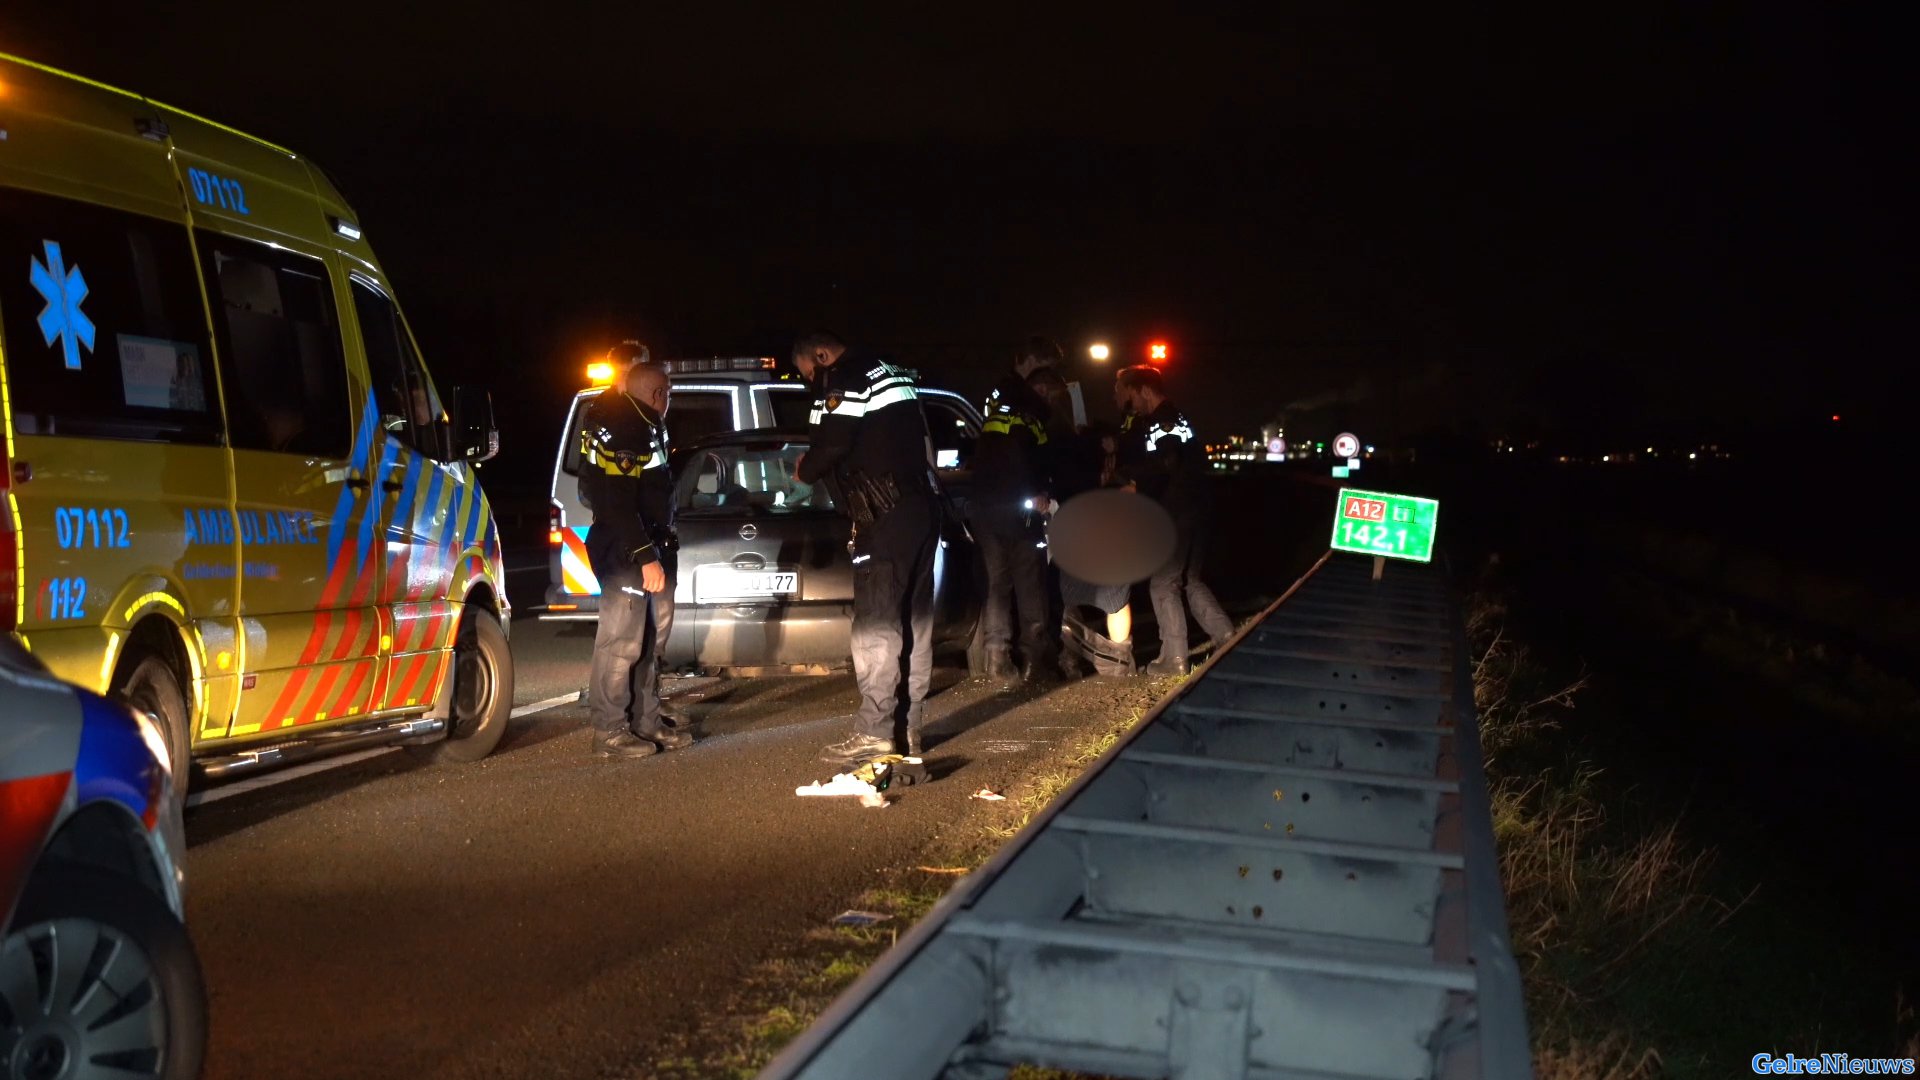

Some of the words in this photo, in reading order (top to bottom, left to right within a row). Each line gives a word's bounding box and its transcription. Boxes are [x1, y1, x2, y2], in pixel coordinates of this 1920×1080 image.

[188, 167, 250, 215] 07112
[55, 507, 131, 549] 07112
[183, 507, 319, 545] AMBULANCE
[1348, 501, 1382, 519] A12
[1342, 522, 1407, 551] 142,1
